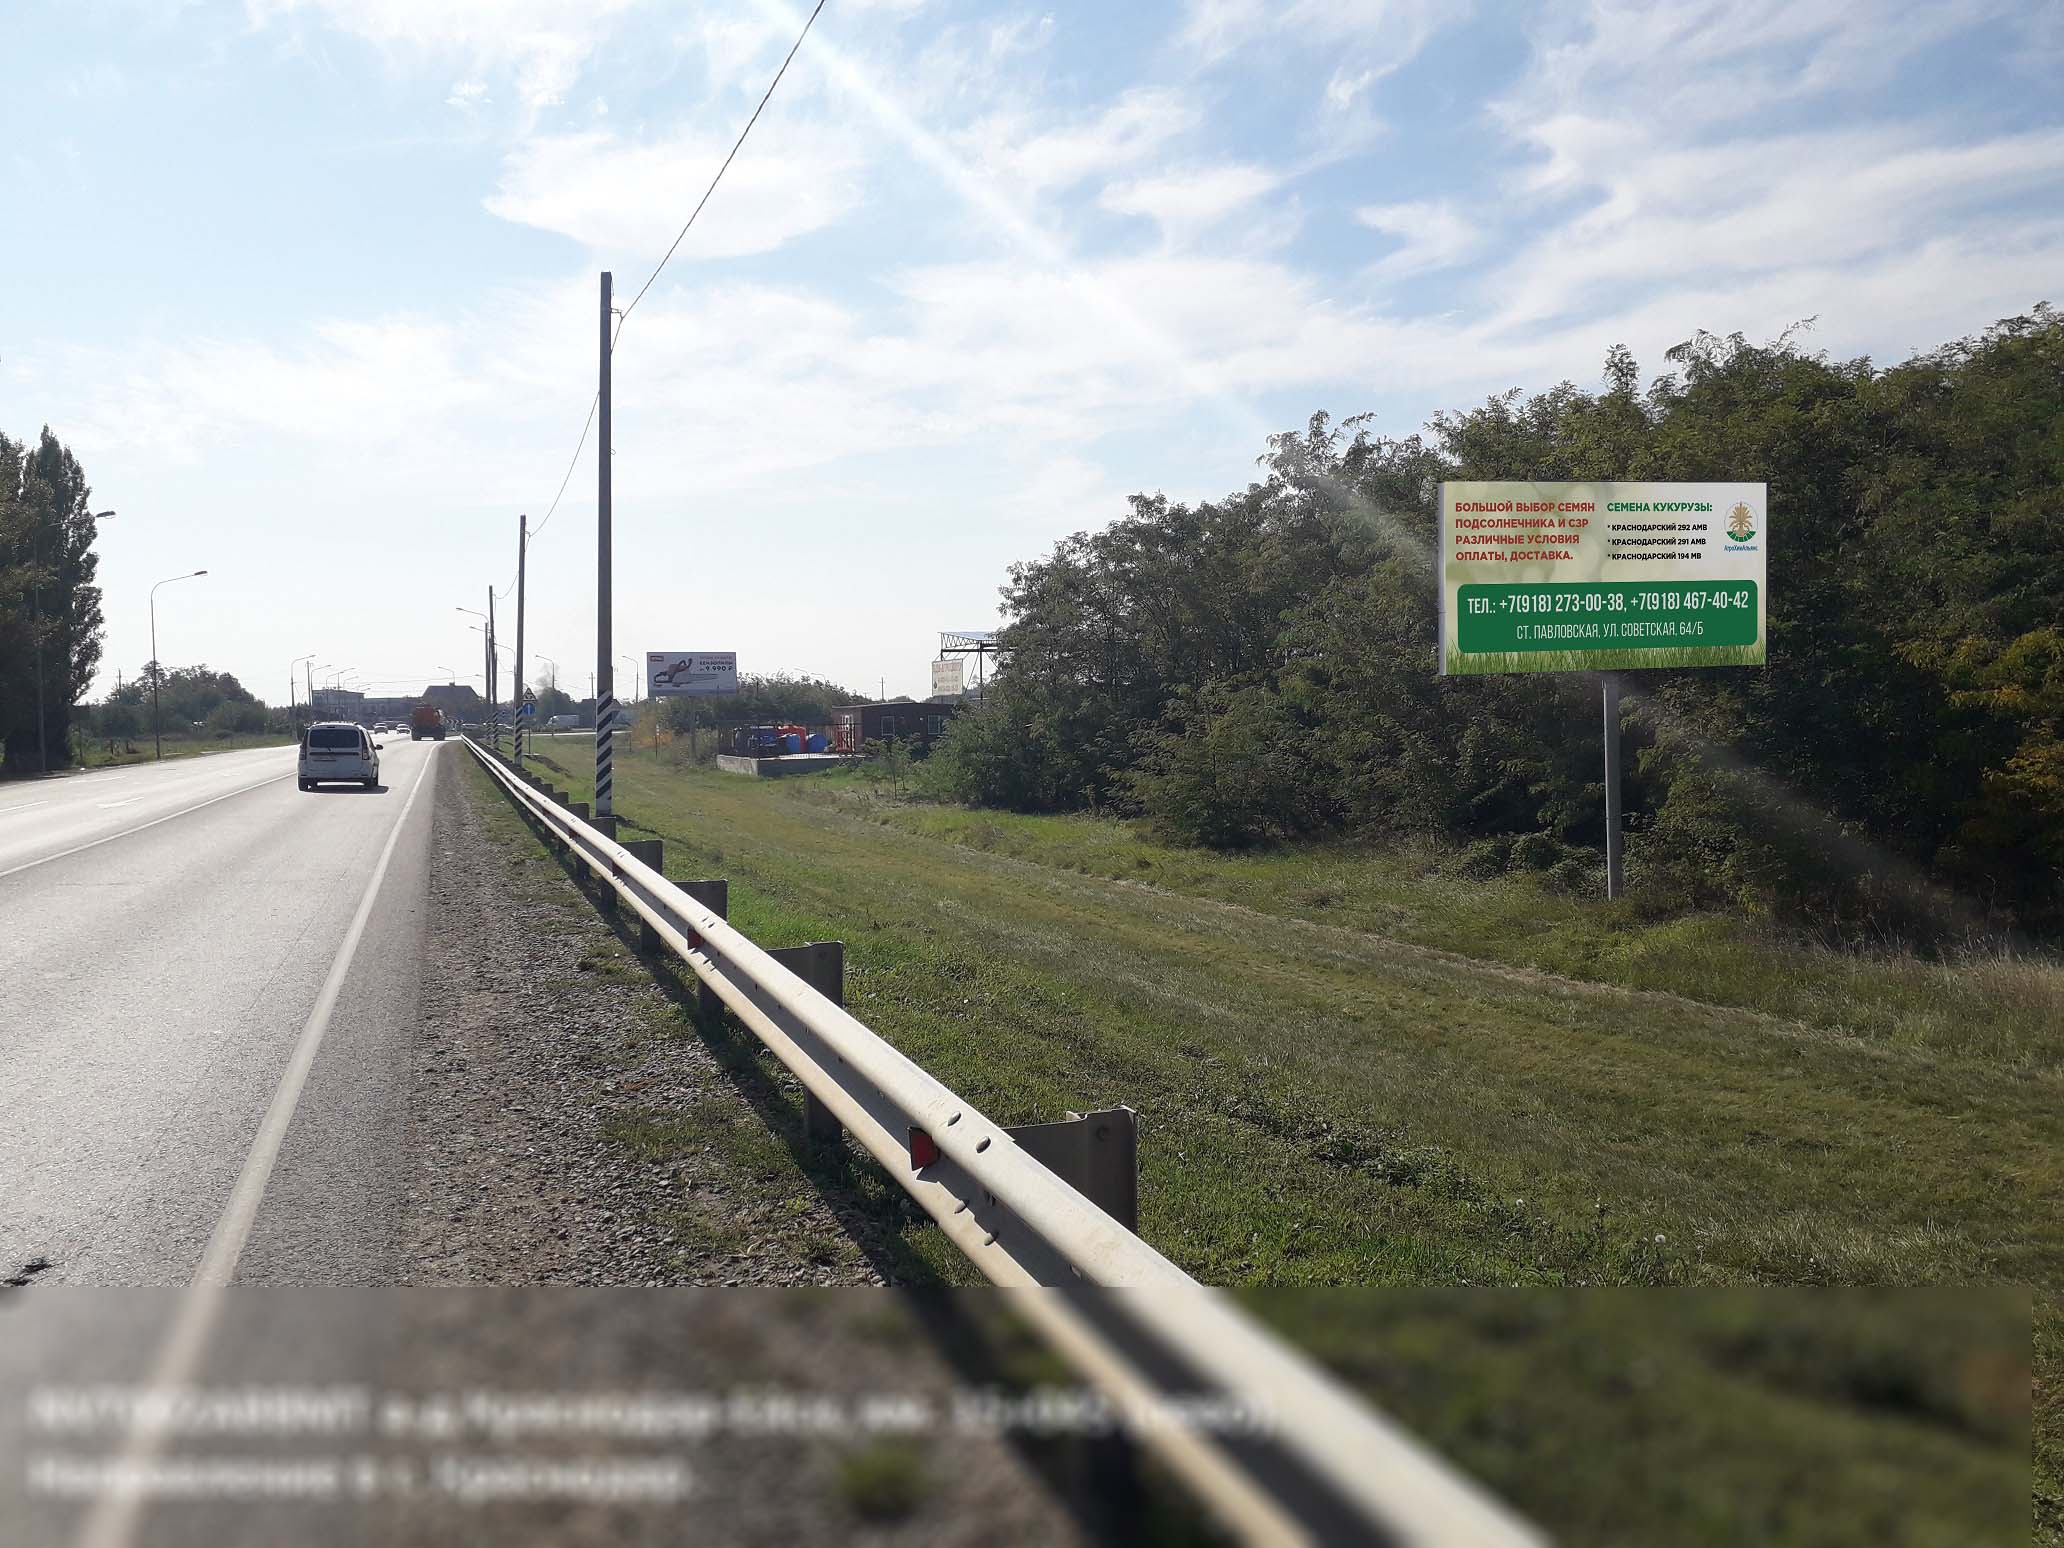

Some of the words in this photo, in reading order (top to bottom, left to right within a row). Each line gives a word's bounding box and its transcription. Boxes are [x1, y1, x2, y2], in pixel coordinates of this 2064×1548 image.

[1455, 500, 1513, 512] БОЛЬШОЙ
[1516, 502, 1555, 512] ВЫБОР
[1557, 502, 1595, 512] СЕМЯН
[1607, 502, 1650, 512] СЕМЕНА
[1653, 502, 1713, 512] КУКУРУЗЫ:
[1455, 518, 1555, 530] ПОДСОЛНЕЧНИКА
[1558, 518, 1566, 528] И
[1568, 518, 1589, 528] СЗР
[1612, 523, 1676, 533] КРАСНОДАРСКИЙ
[1455, 535, 1524, 545] РАЗЛИЧНЫЕ
[1527, 534, 1580, 545] УСЛОВИЯ
[1612, 537, 1676, 547] КРАСНОДАРСКИЙ
[1677, 538, 1689, 546] 291
[1455, 551, 1508, 562] ОПЛАТЫ,
[1510, 550, 1574, 562] ДОСТАВКА.
[1612, 551, 1676, 561] КРАСНОДАРСКИЙ
[1678, 552, 1690, 560] 194
[1467, 598, 1496, 614] ТЕЛ.:
[1499, 594, 1552, 613] +7(918)
[1555, 593, 1627, 613] 273-00-38,
[1630, 592, 1680, 611] +7(918)
[1683, 591, 1749, 609] 467-40-42
[1516, 625, 1532, 640] СТ.
[1603, 623, 1619, 637] УЛ.
[1679, 621, 1704, 636] 64/Б
